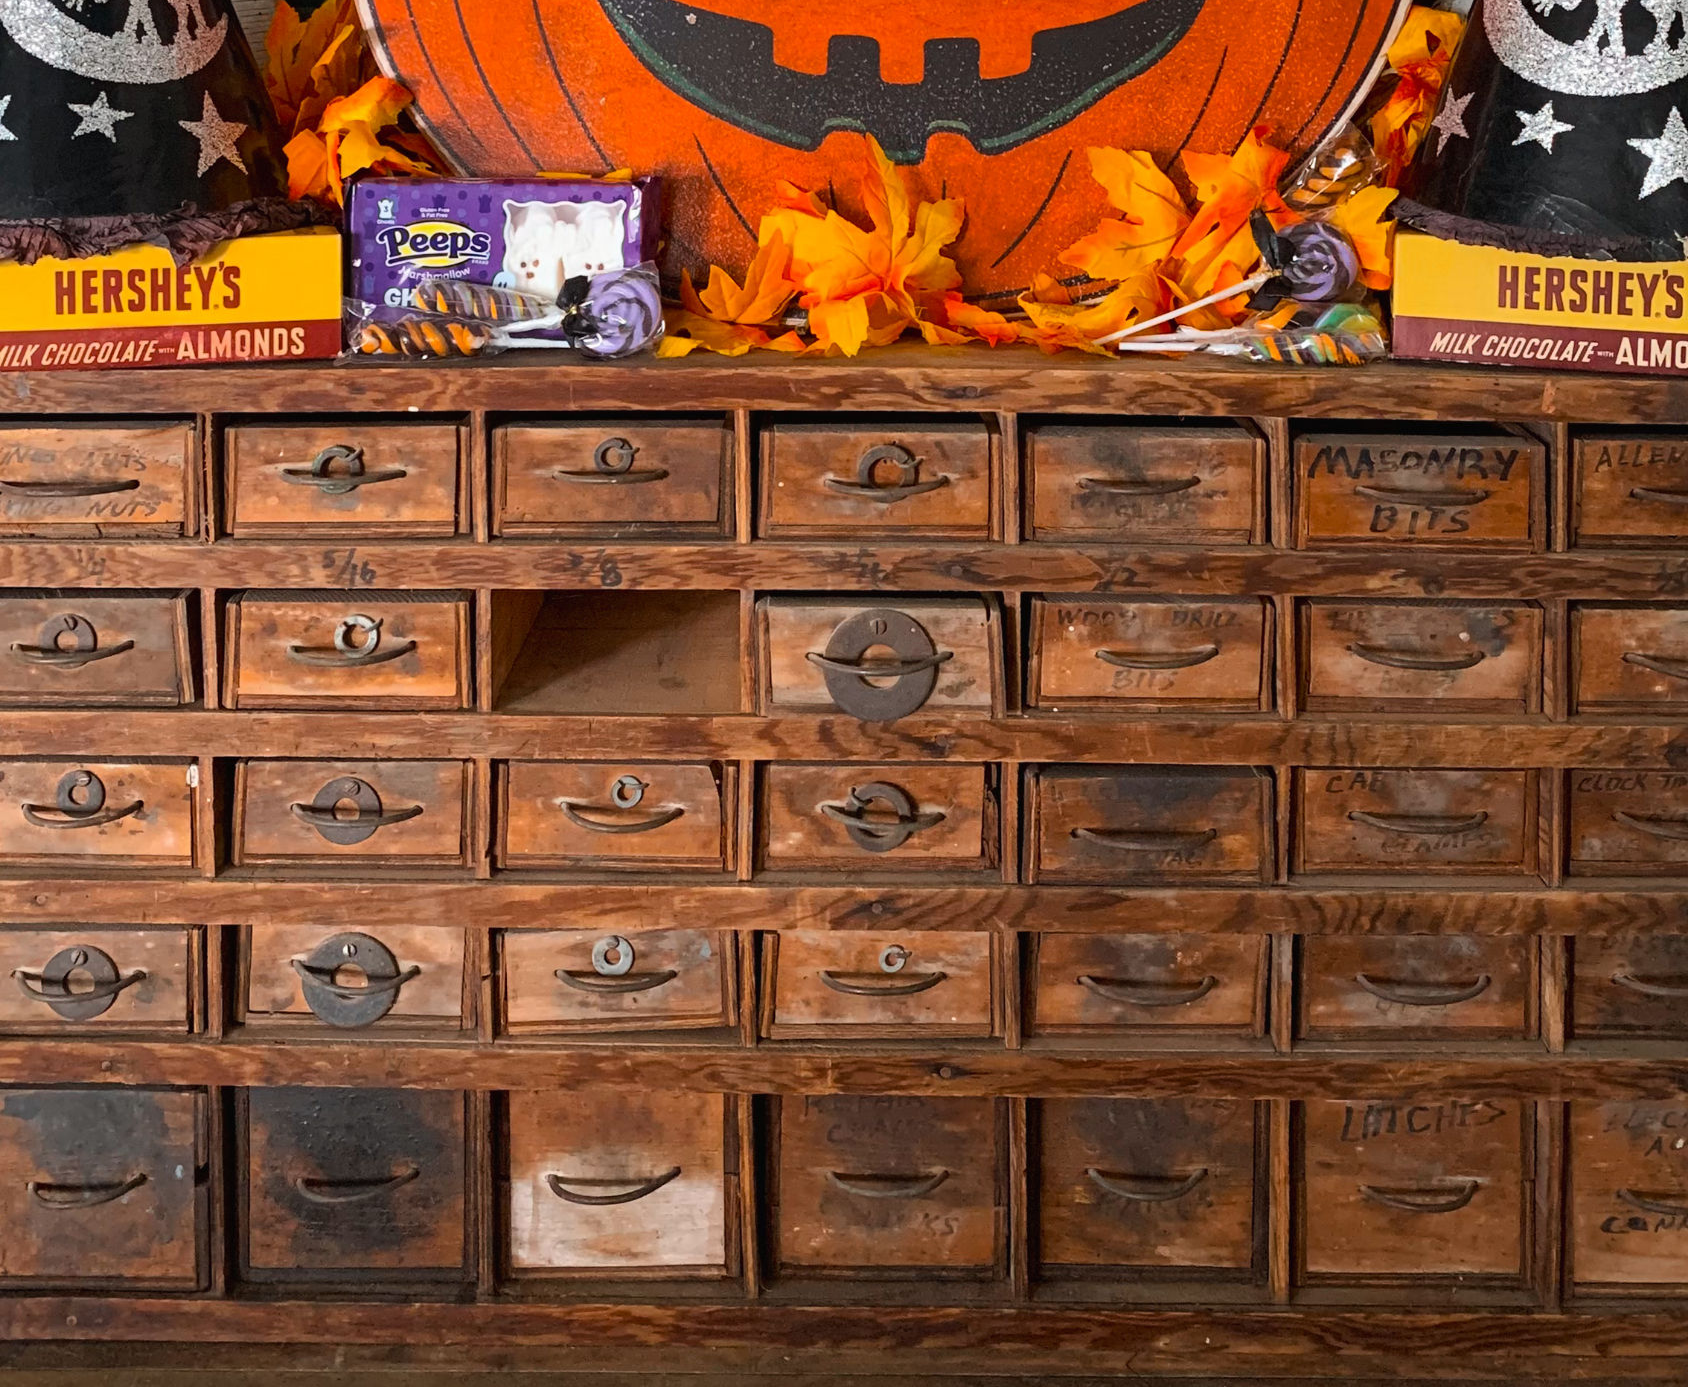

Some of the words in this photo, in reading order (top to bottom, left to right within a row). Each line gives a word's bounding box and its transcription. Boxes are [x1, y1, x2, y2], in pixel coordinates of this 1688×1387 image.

[376, 226, 491, 260] Peeps
[55, 261, 241, 315] HERSHEY'S
[398, 266, 471, 285] Marshmallow
[1498, 264, 1685, 320] HERSHEY'S
[41, 340, 159, 366] CHOCOLATE
[176, 327, 306, 361] ALMONDS
[1430, 332, 1481, 355] MILK
[1482, 335, 1599, 364] CHOCOLATE
[1597, 350, 1615, 358] WITH
[1308, 445, 1519, 481] MASONRY
[85, 499, 161, 518] NUTS
[1370, 504, 1470, 535] BITS
[322, 547, 377, 588] 5/16
[1112, 670, 1179, 691] BITS
[1577, 773, 1648, 792] CLOCK
